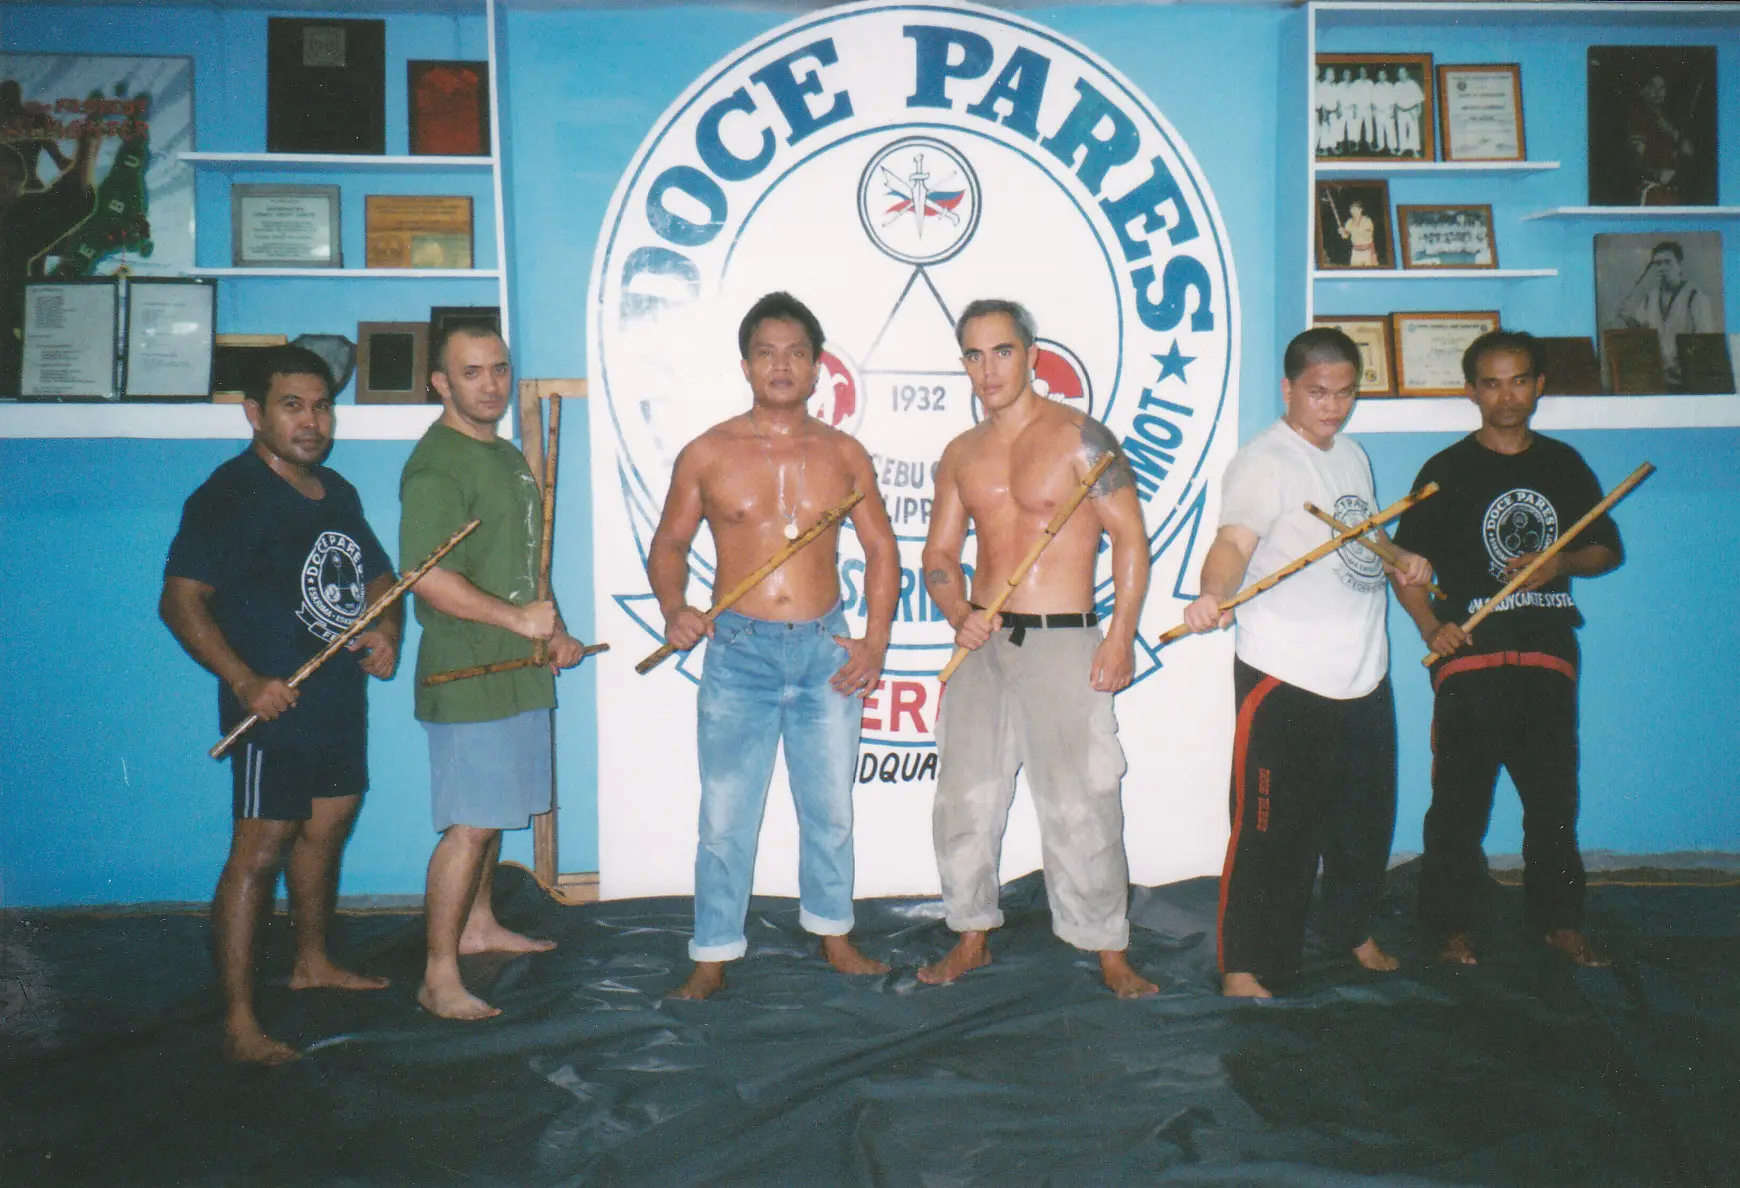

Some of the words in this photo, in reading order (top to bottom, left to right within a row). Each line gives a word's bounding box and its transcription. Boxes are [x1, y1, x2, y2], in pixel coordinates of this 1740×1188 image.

[619, 37, 855, 330] DOCE
[902, 25, 1215, 333] PARES
[891, 384, 947, 413] 1932
[1121, 387, 1194, 503] MOT
[884, 494, 934, 525] IPP
[1486, 495, 1514, 530] DOCE
[1516, 492, 1555, 526] PARES
[306, 537, 329, 577] DOCE
[329, 534, 363, 575] PARES
[1545, 591, 1575, 609] SYSTE
[860, 680, 946, 734] ER
[853, 751, 938, 784] DQUA
